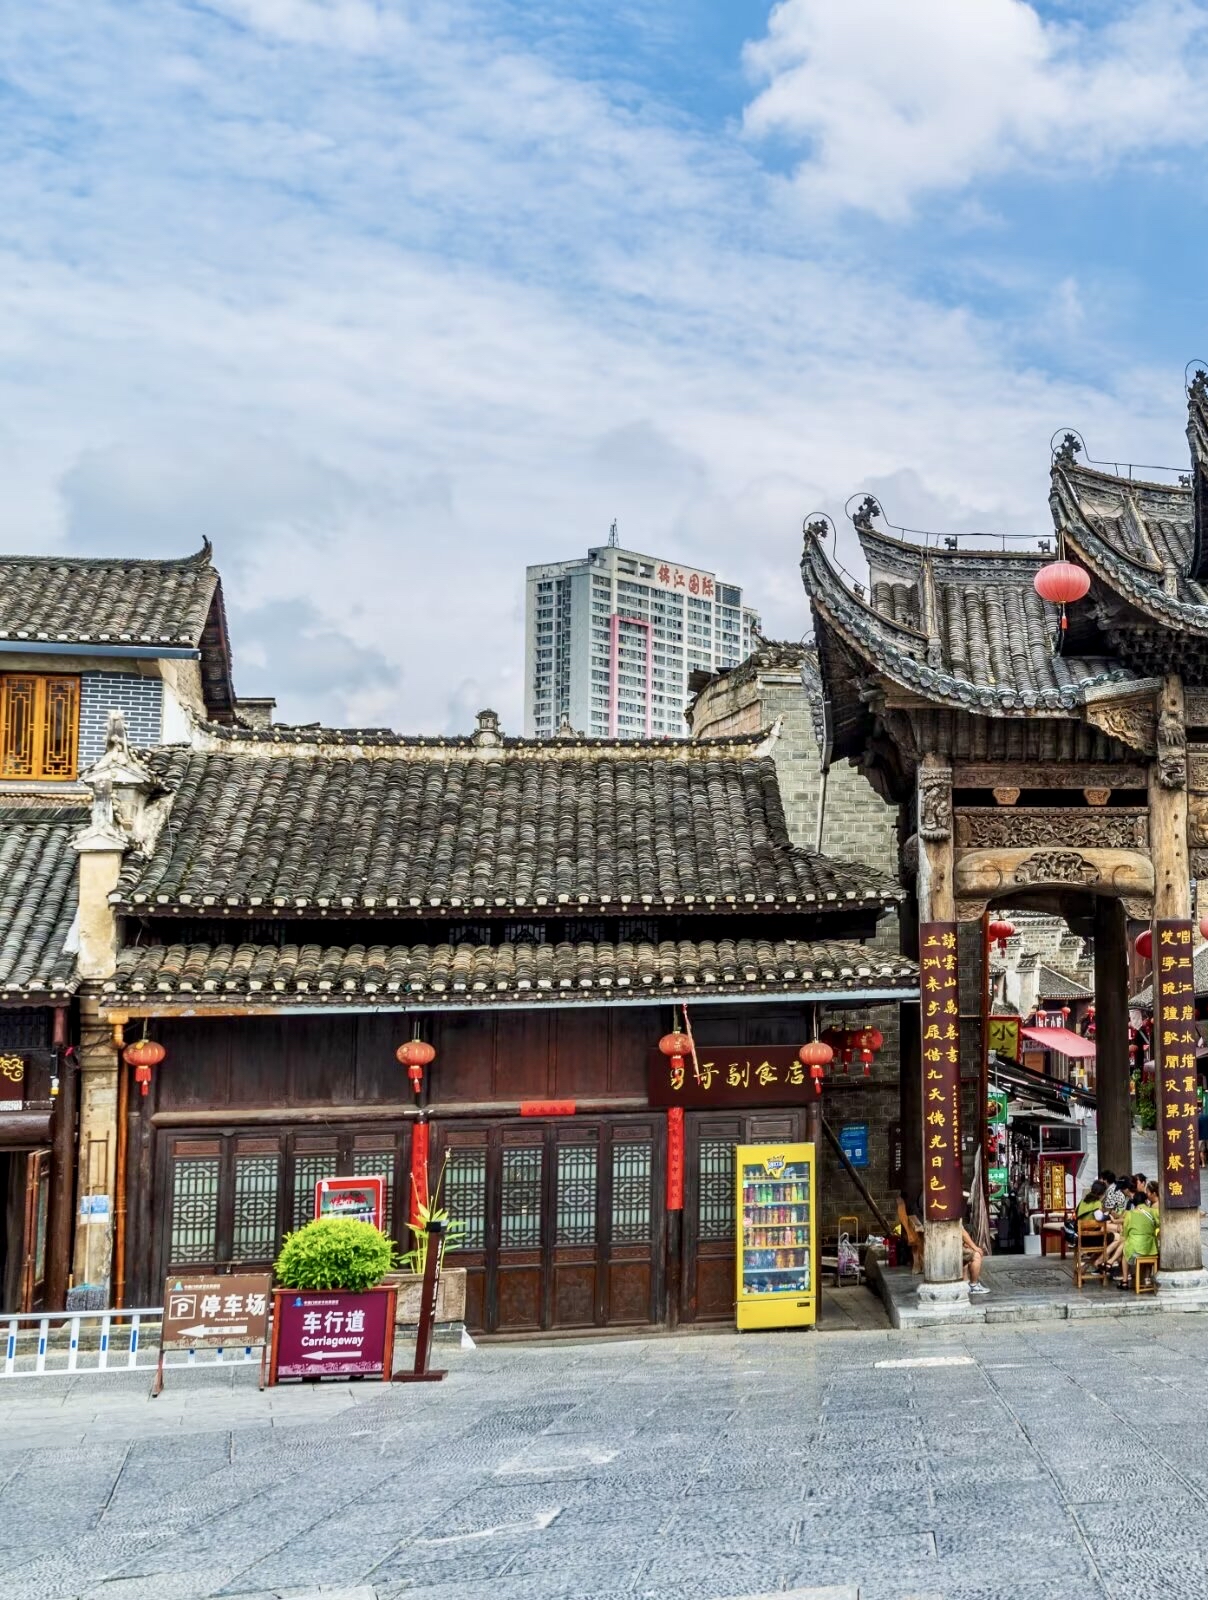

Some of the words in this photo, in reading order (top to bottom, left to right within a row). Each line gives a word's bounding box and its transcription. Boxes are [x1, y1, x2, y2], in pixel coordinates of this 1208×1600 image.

[656, 563, 715, 597] 锦江国际
[176, 1303, 189, 1317] P
[199, 1293, 266, 1318] 停车场
[302, 1309, 365, 1334] 车行道
[301, 1335, 364, 1348] Carriageway
